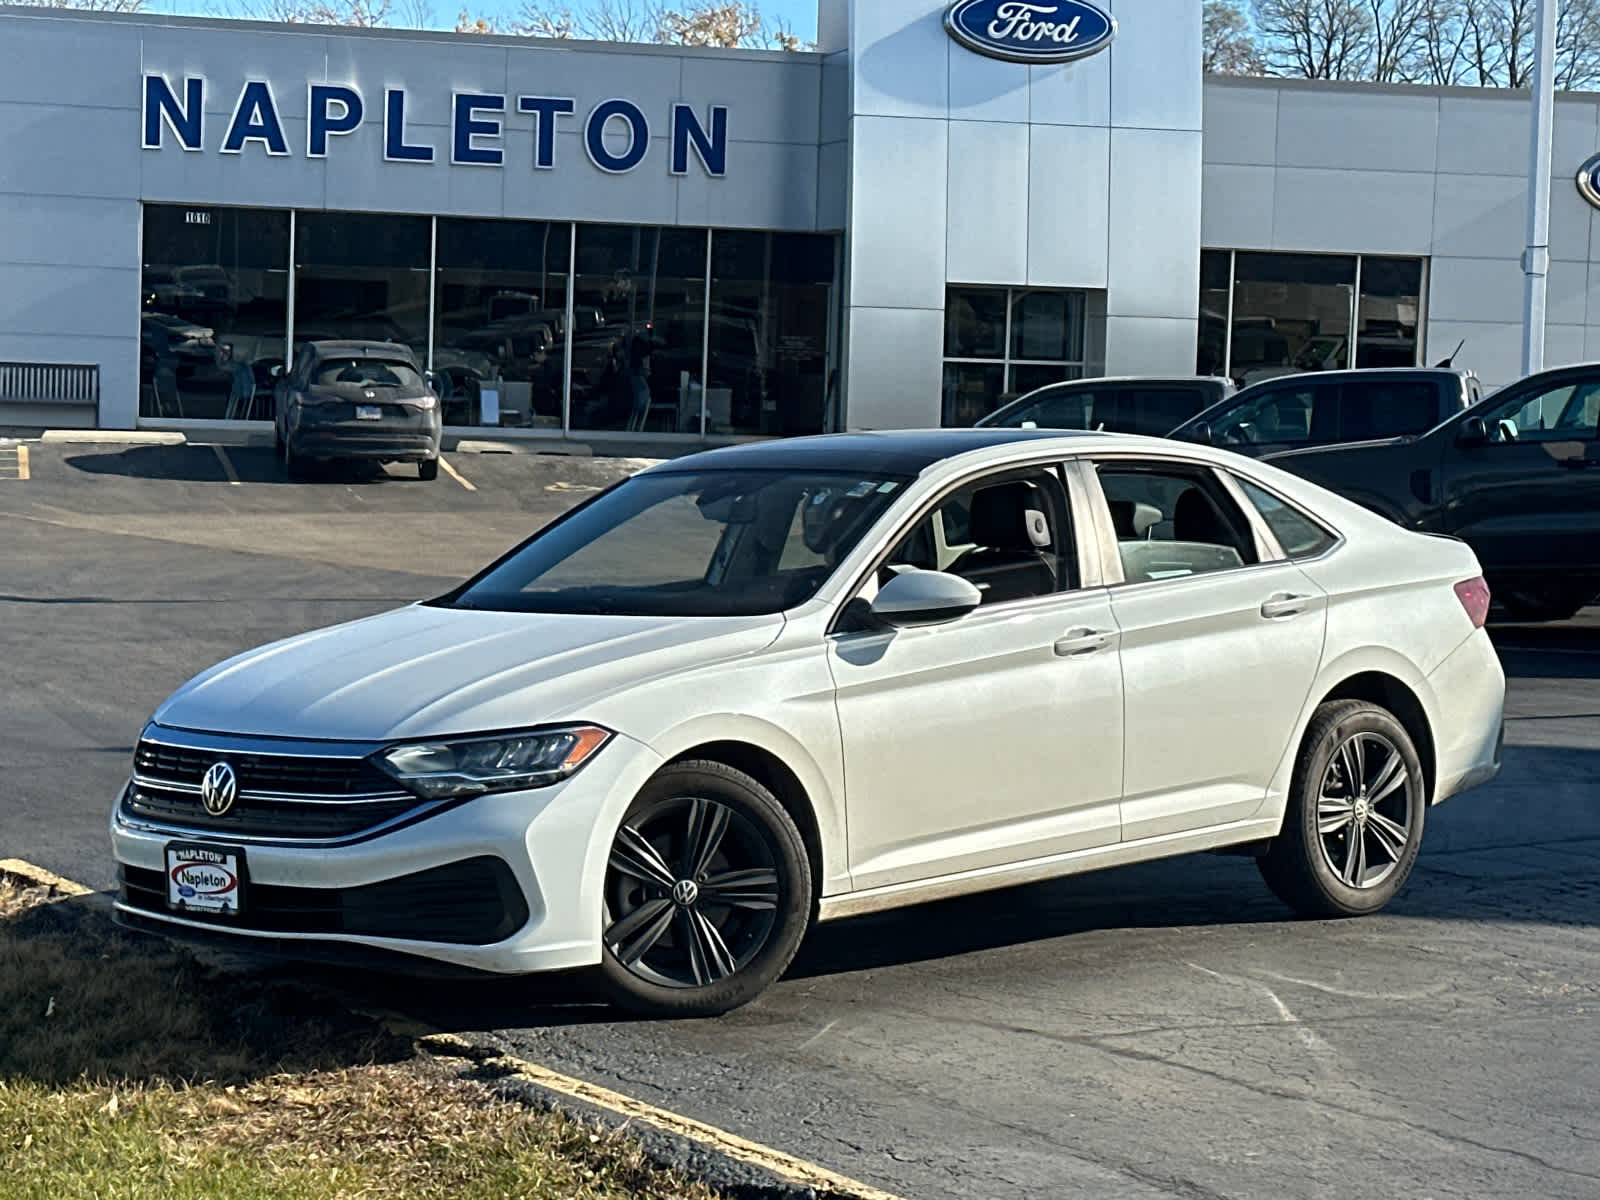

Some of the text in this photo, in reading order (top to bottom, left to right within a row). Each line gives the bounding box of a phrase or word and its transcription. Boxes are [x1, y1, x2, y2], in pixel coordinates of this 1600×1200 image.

[987, 2, 1081, 43] Ford
[141, 72, 728, 177] NAPLETON
[181, 870, 226, 888] Napleton
